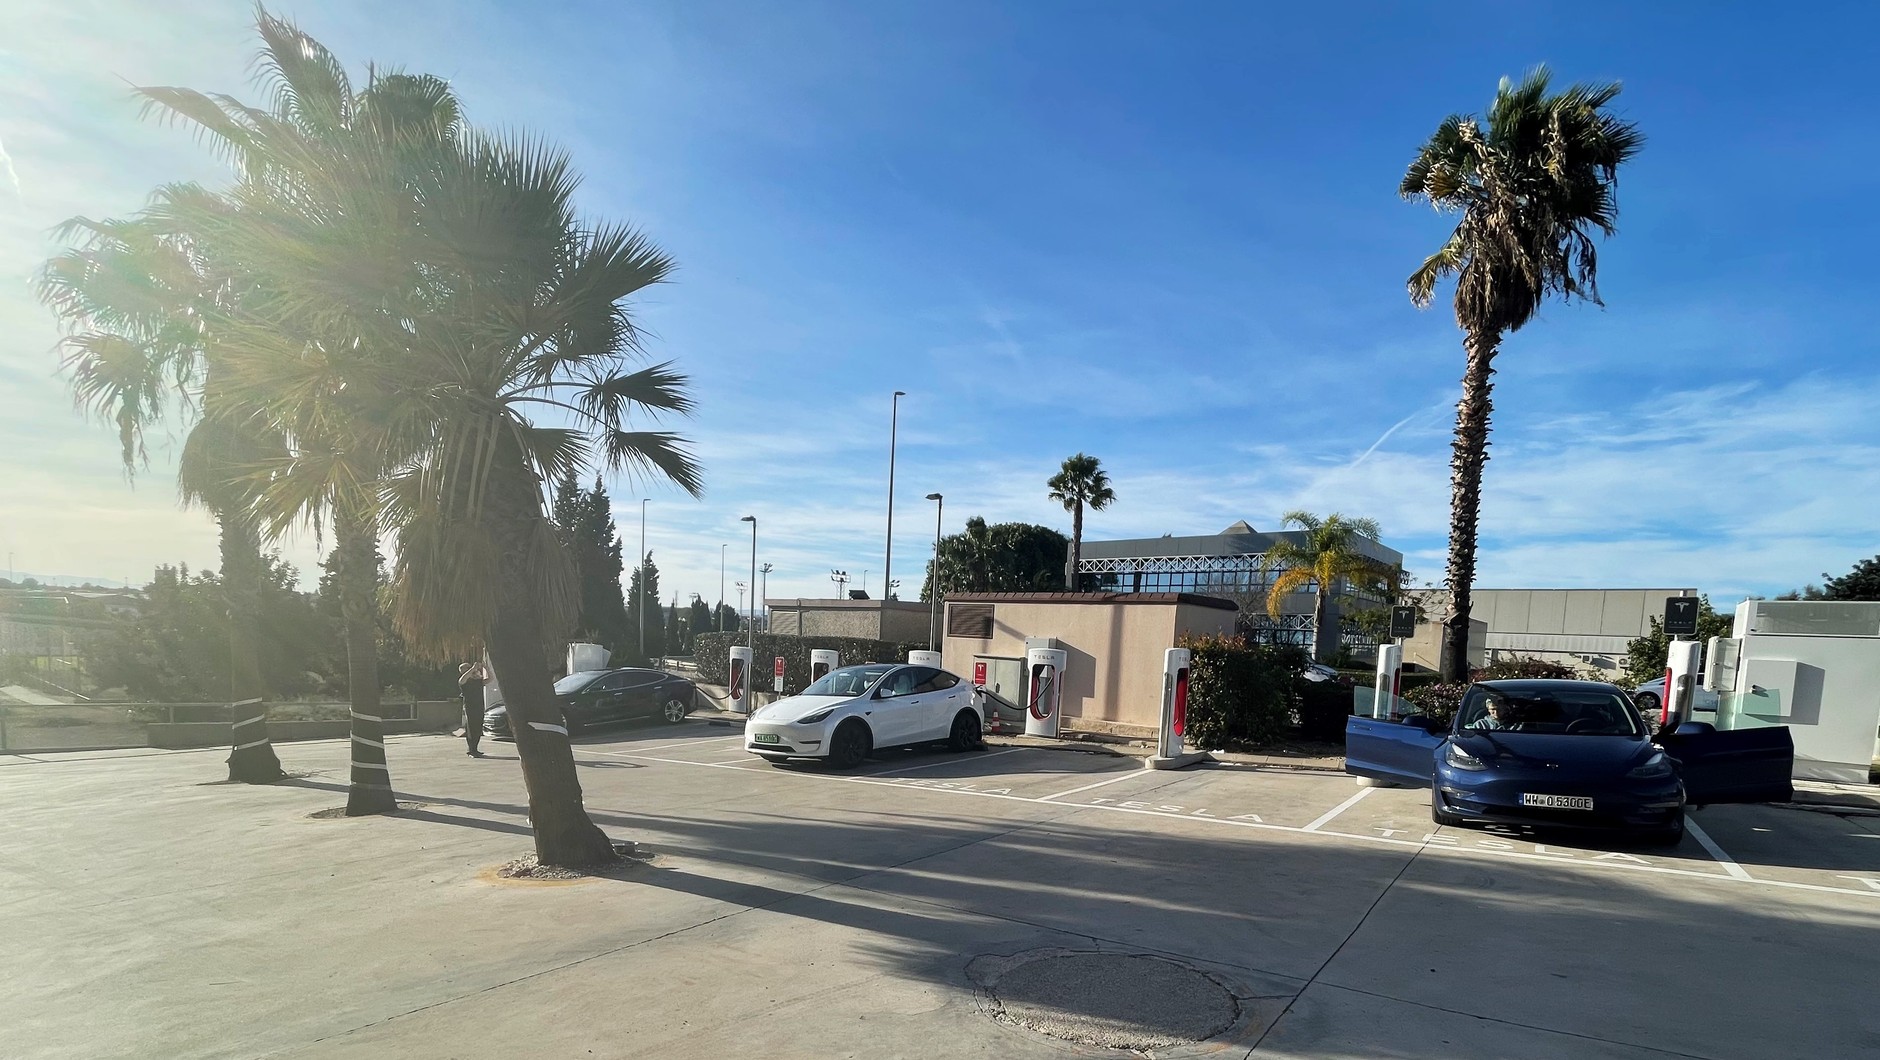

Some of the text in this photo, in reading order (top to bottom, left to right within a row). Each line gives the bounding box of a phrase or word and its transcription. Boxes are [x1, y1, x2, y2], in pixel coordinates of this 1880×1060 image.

[890, 777, 1012, 795] TESLA
[1091, 797, 1264, 823] TESLA
[1556, 796, 1592, 809] 5300E
[1373, 827, 1652, 865] TESLA
